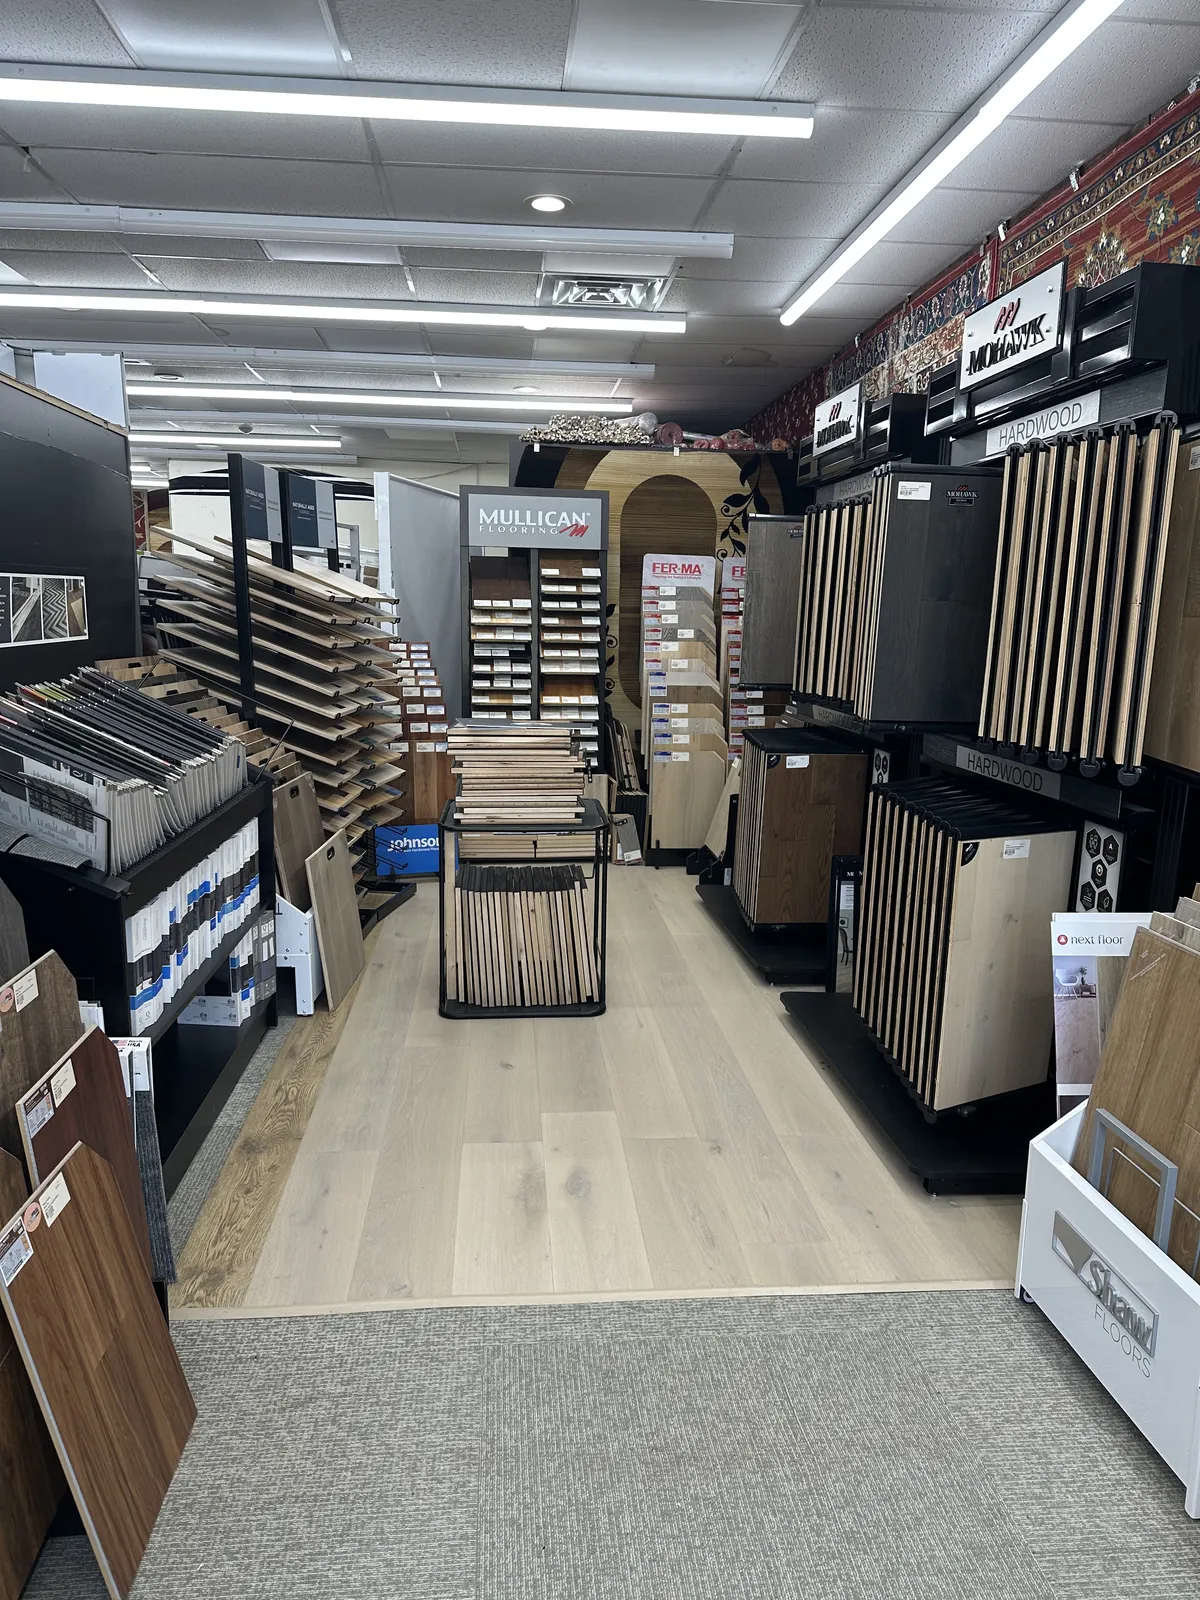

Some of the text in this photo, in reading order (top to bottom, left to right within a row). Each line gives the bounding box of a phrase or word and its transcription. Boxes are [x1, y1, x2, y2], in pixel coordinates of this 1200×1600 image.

[967, 313, 1047, 376] MOHAWK
[816, 414, 853, 448] MOHAWK
[999, 402, 1082, 447] HARDWOOD
[840, 477, 872, 496] HARDWOO
[946, 490, 978, 498] MOHAWK
[479, 508, 587, 527] MULLICAN
[479, 525, 558, 535] FLOORING
[968, 752, 1043, 791] HARDWOOD
[1071, 934, 1124, 945] next floor
[1087, 1259, 1153, 1347] Shaw
[1094, 1303, 1151, 1378] FLOORS
